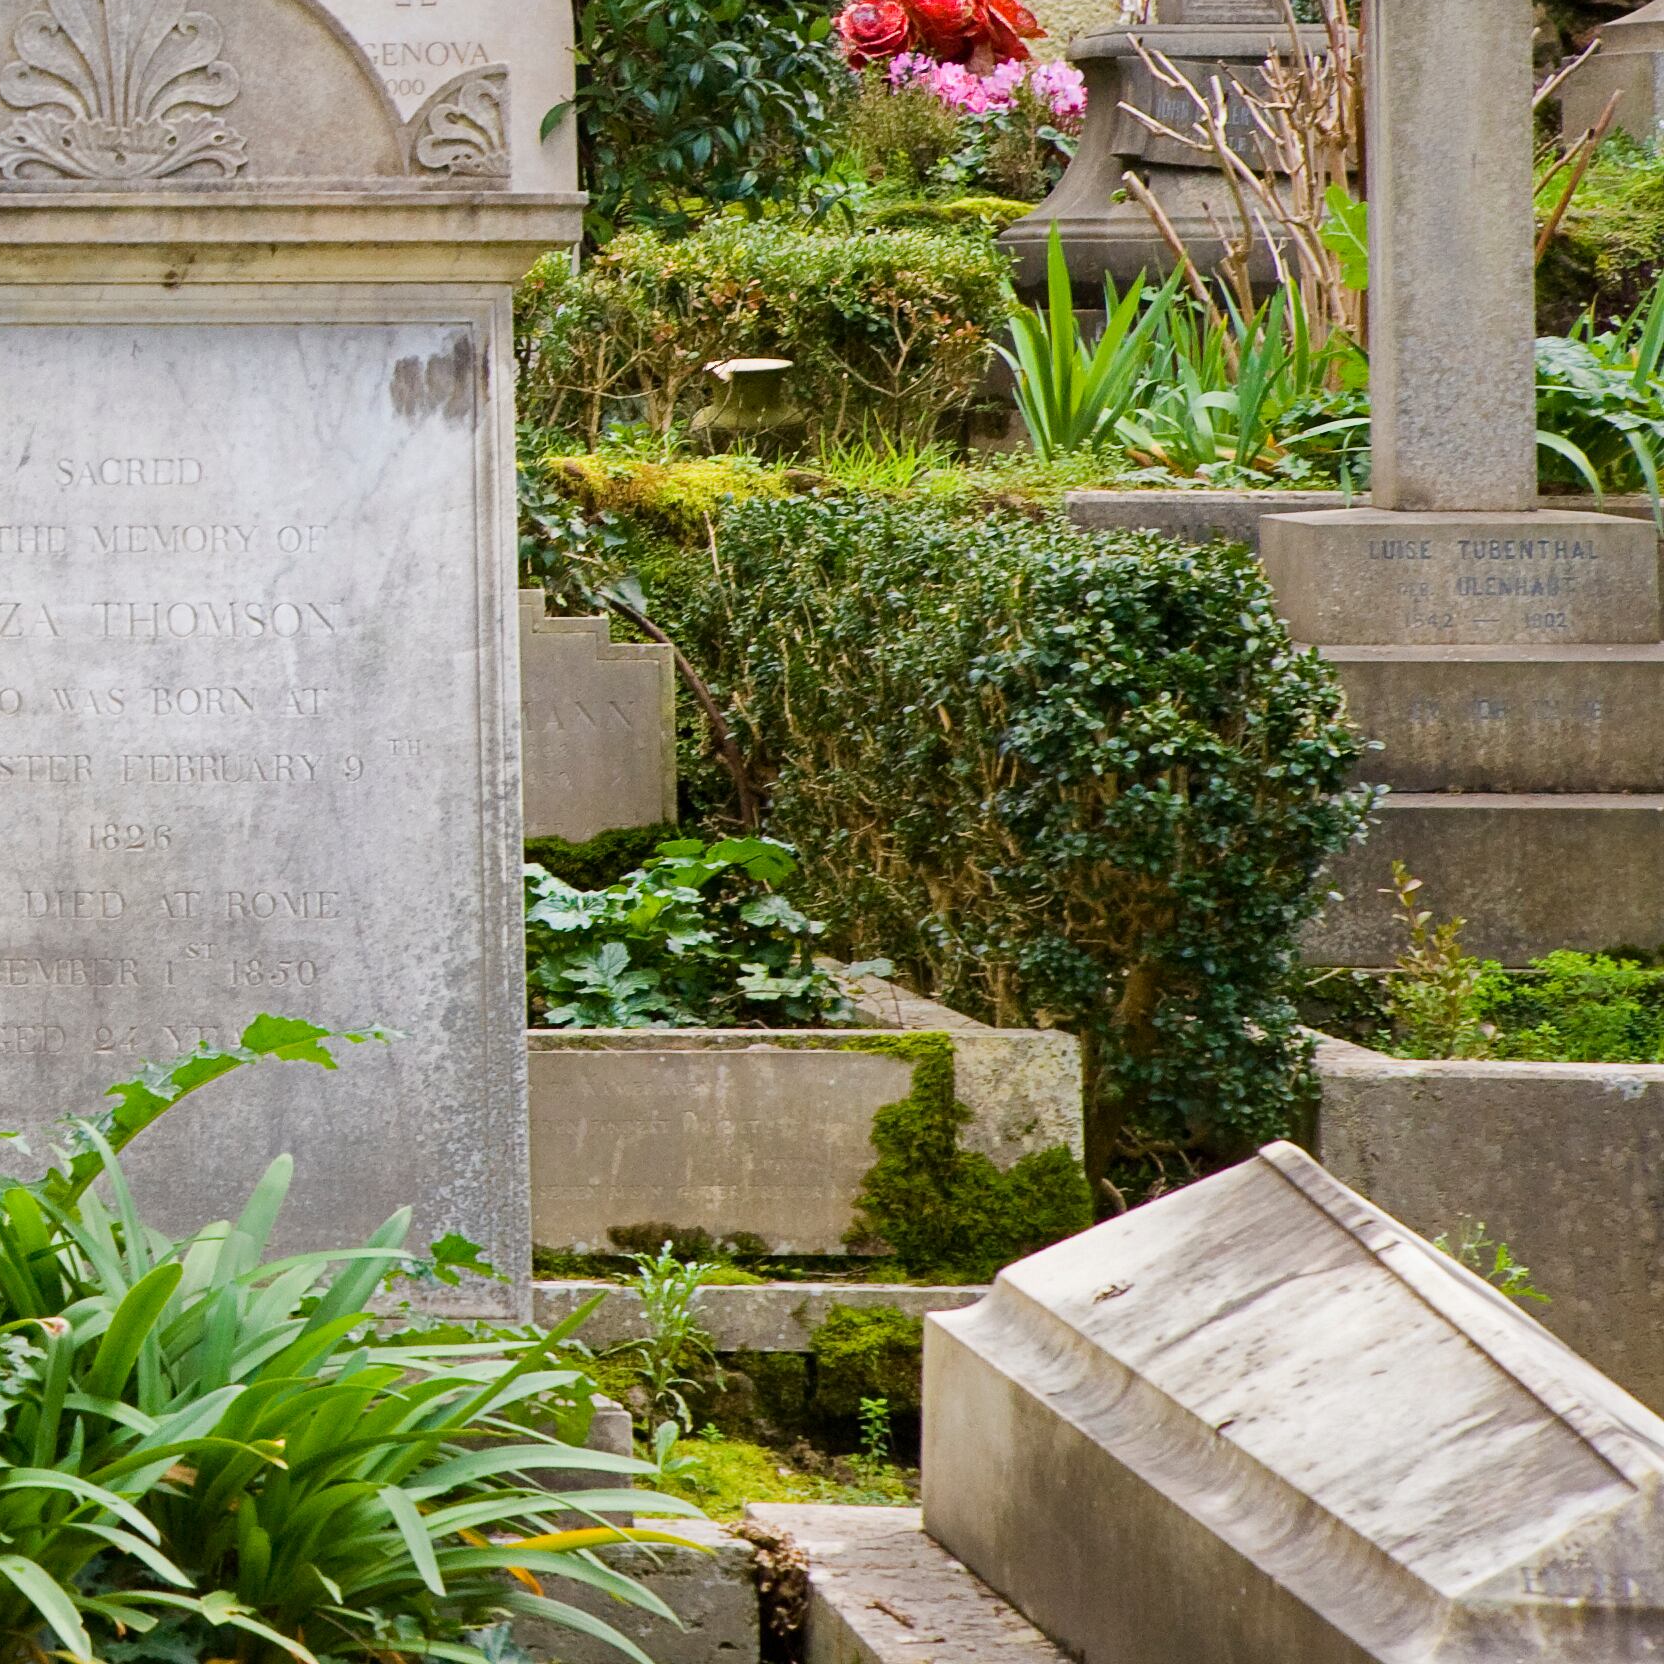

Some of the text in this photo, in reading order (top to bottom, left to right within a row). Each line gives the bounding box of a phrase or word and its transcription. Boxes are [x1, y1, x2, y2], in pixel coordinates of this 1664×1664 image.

[365, 41, 490, 67] GENOVA
[56, 458, 204, 488] SACRED
[92, 524, 260, 554] MEMORY
[276, 524, 329, 554] OF
[1368, 539, 1600, 561] LUISE TUBENTHAL
[92, 601, 344, 639] THOMSON
[52, 687, 126, 717] WAS
[152, 687, 256, 717] BORN
[283, 687, 328, 717] AT
[119, 753, 324, 785] FEBRUARY
[342, 755, 366, 784] 9
[88, 823, 173, 852] 1826
[24, 890, 128, 921] DIED
[158, 889, 202, 921] AT
[226, 890, 341, 921] ROME
[229, 958, 320, 988] 1850
[94, 1025, 141, 1055] 24
